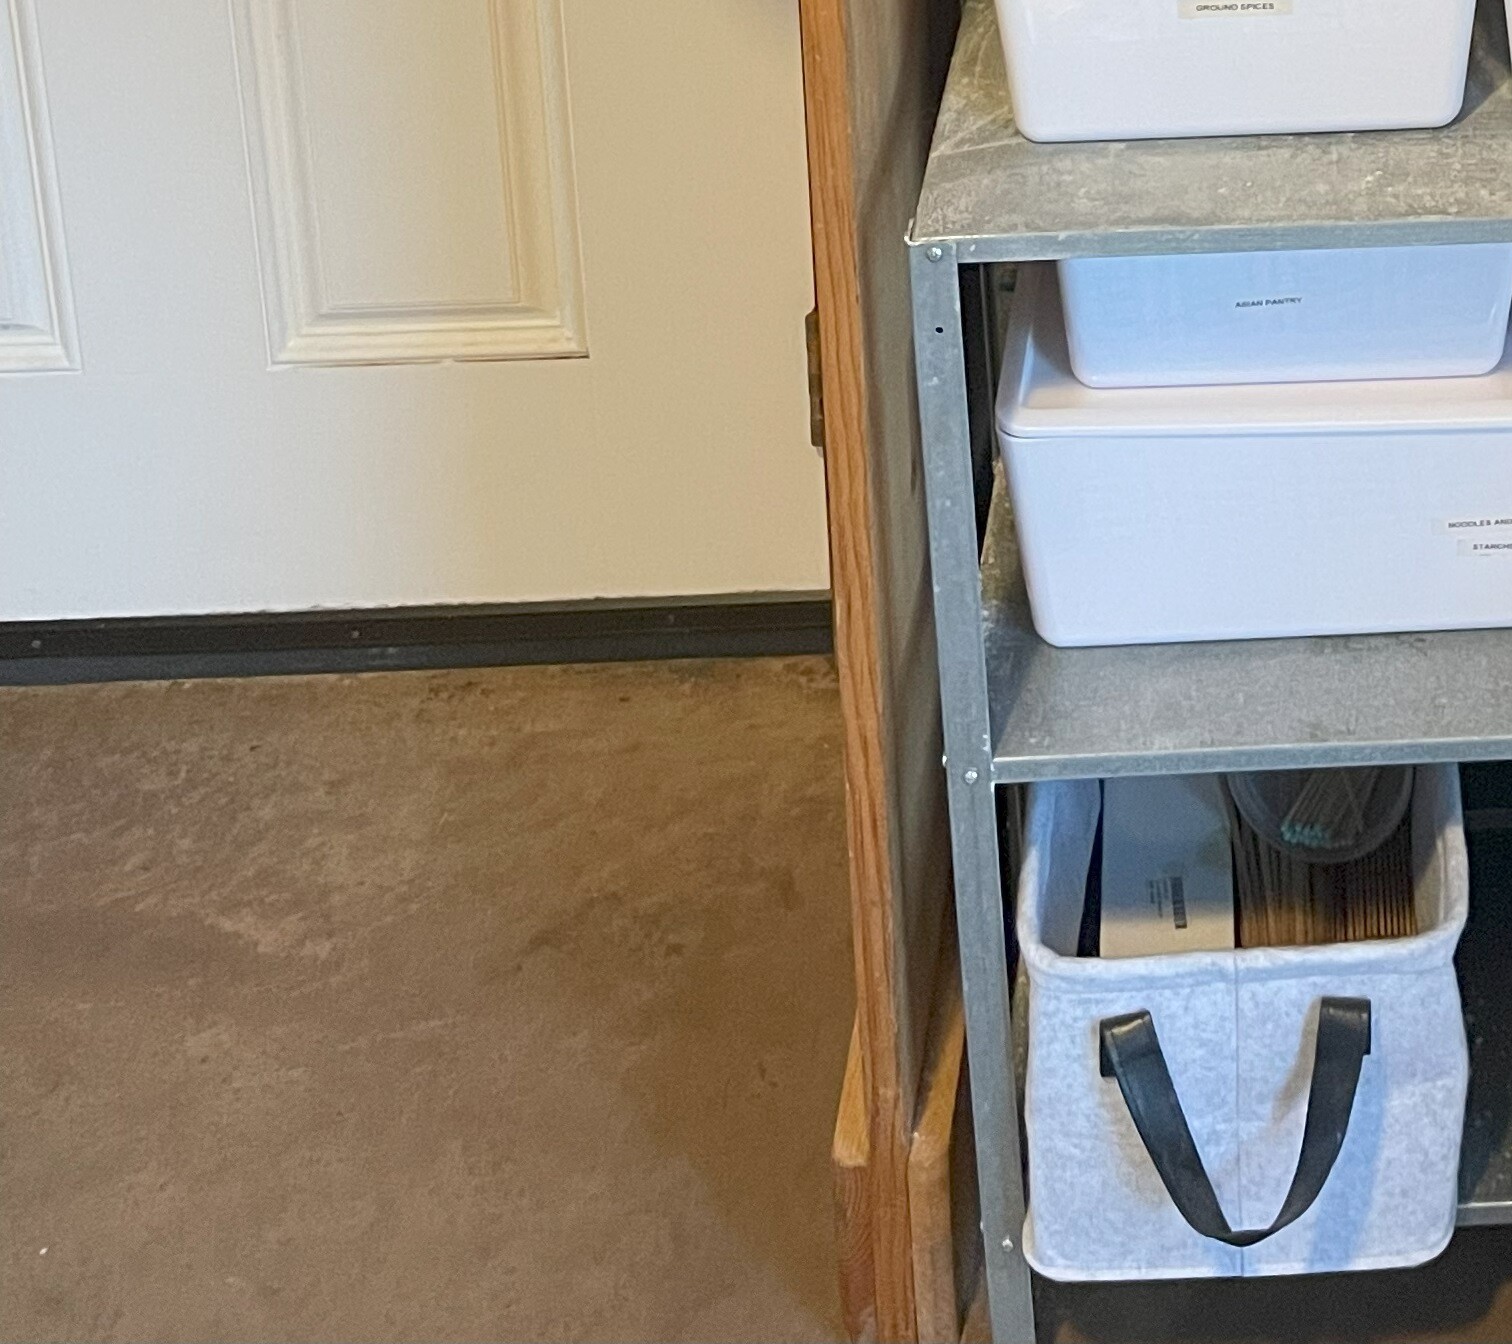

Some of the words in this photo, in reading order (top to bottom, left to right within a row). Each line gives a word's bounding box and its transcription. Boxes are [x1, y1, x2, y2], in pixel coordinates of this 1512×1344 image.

[1196, 4, 1239, 12] GROUND
[1240, 2, 1275, 11] SPICES
[1265, 297, 1303, 306] PANTRY
[1448, 520, 1492, 528] NOODLES
